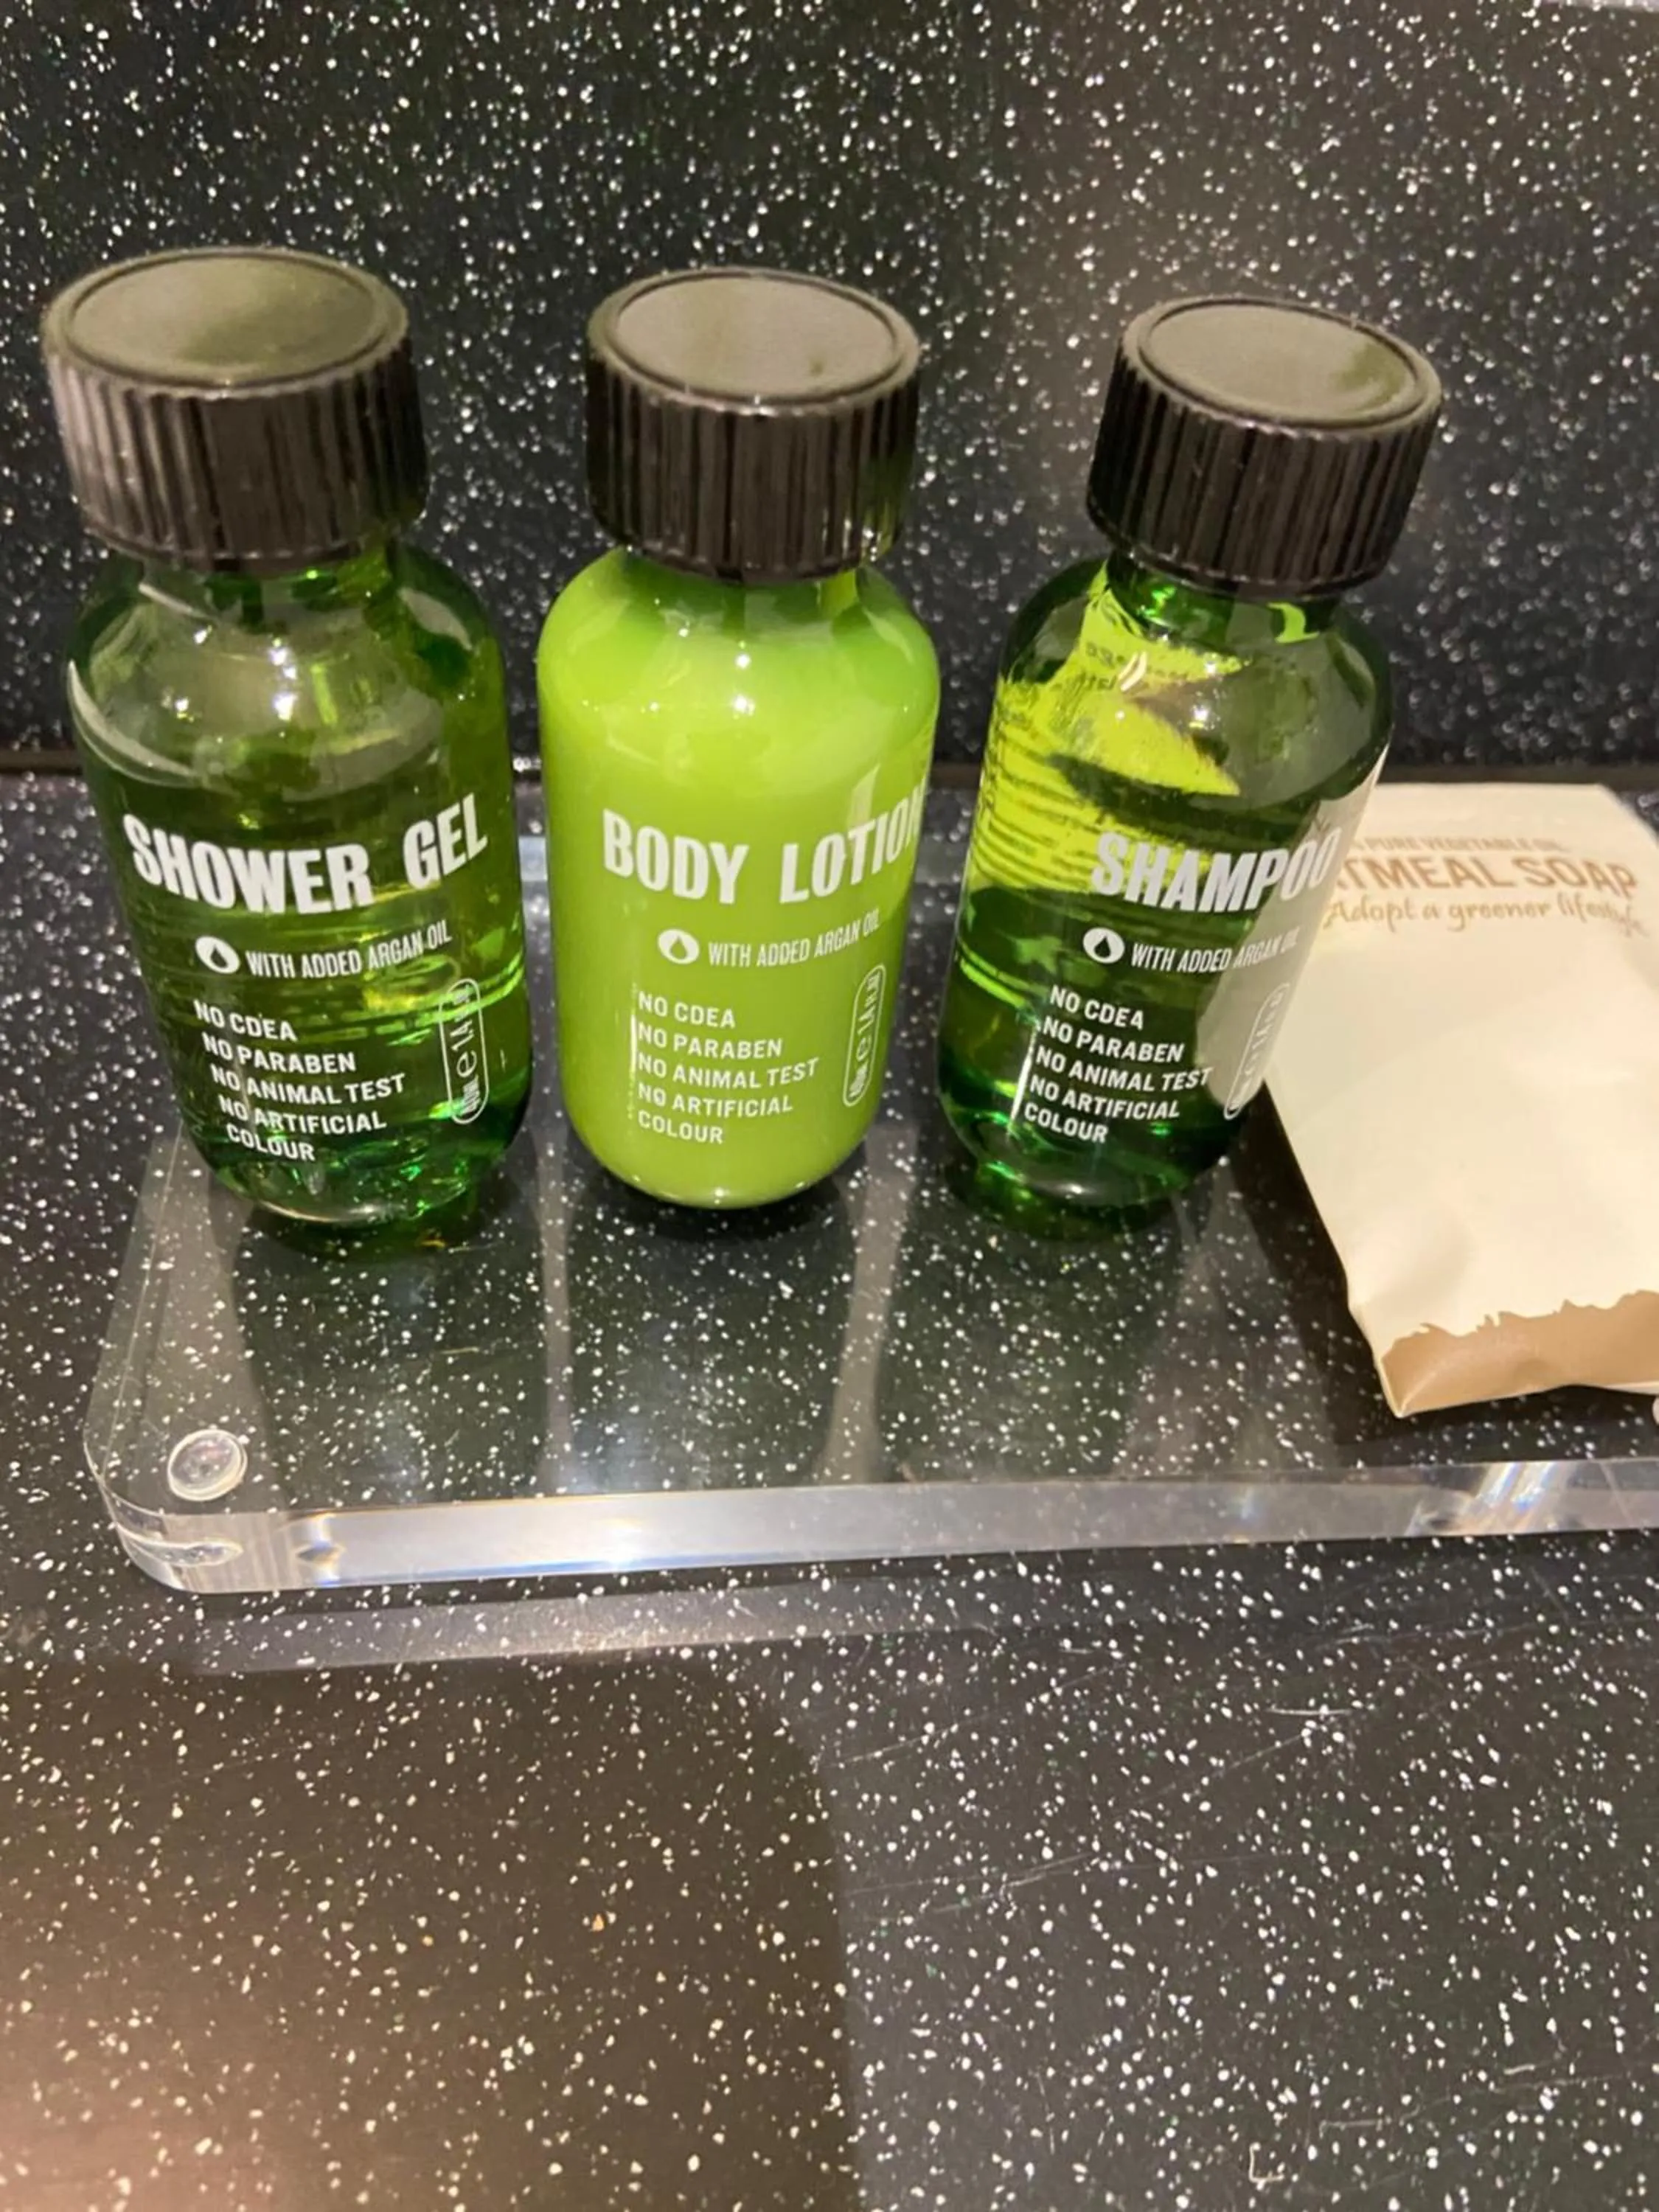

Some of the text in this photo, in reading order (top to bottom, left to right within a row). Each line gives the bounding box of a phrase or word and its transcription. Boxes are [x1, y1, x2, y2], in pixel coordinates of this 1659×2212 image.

[122, 793, 488, 914] SHOWER GEL
[603, 808, 749, 905] BODY
[1091, 827, 1341, 913] SHAMPOO
[1336, 855, 1638, 900] TMEAL SOAP
[1323, 893, 1419, 933] Adopt
[1422, 904, 1441, 919] a
[1447, 901, 1551, 932] greener
[246, 920, 452, 978] WITH ADDED ARGAN OIL
[708, 908, 880, 967] WITH ADDED ARGAN OIL
[1130, 942, 1177, 972] WITH
[1178, 947, 1231, 973] ADDED
[1233, 936, 1281, 969] ARGAN
[193, 1000, 297, 1041] NO CDEA
[638, 991, 736, 1029] NO CDEA
[1050, 984, 1144, 1031] NO CDEA
[202, 1032, 356, 1074] NO PARABEN
[639, 1022, 783, 1058] NO PARABEN
[1043, 1015, 1184, 1062] NO PARABEN
[210, 1064, 406, 1105] NO ANIMAL TEST
[638, 1052, 667, 1077] NO
[672, 1065, 761, 1089] ANIMAL
[768, 1057, 819, 1087] TEST
[1036, 1046, 1213, 1091] NO ANIMAL TEST
[218, 1094, 386, 1135] NO ARTIFICIAL
[637, 1082, 793, 1119] NO ARTIFICIAL
[1030, 1074, 1180, 1120] NO ARTIFICIAL
[226, 1122, 316, 1161] COLOUR
[638, 1110, 724, 1144] COLOUR
[1024, 1102, 1108, 1144] COLOUR
